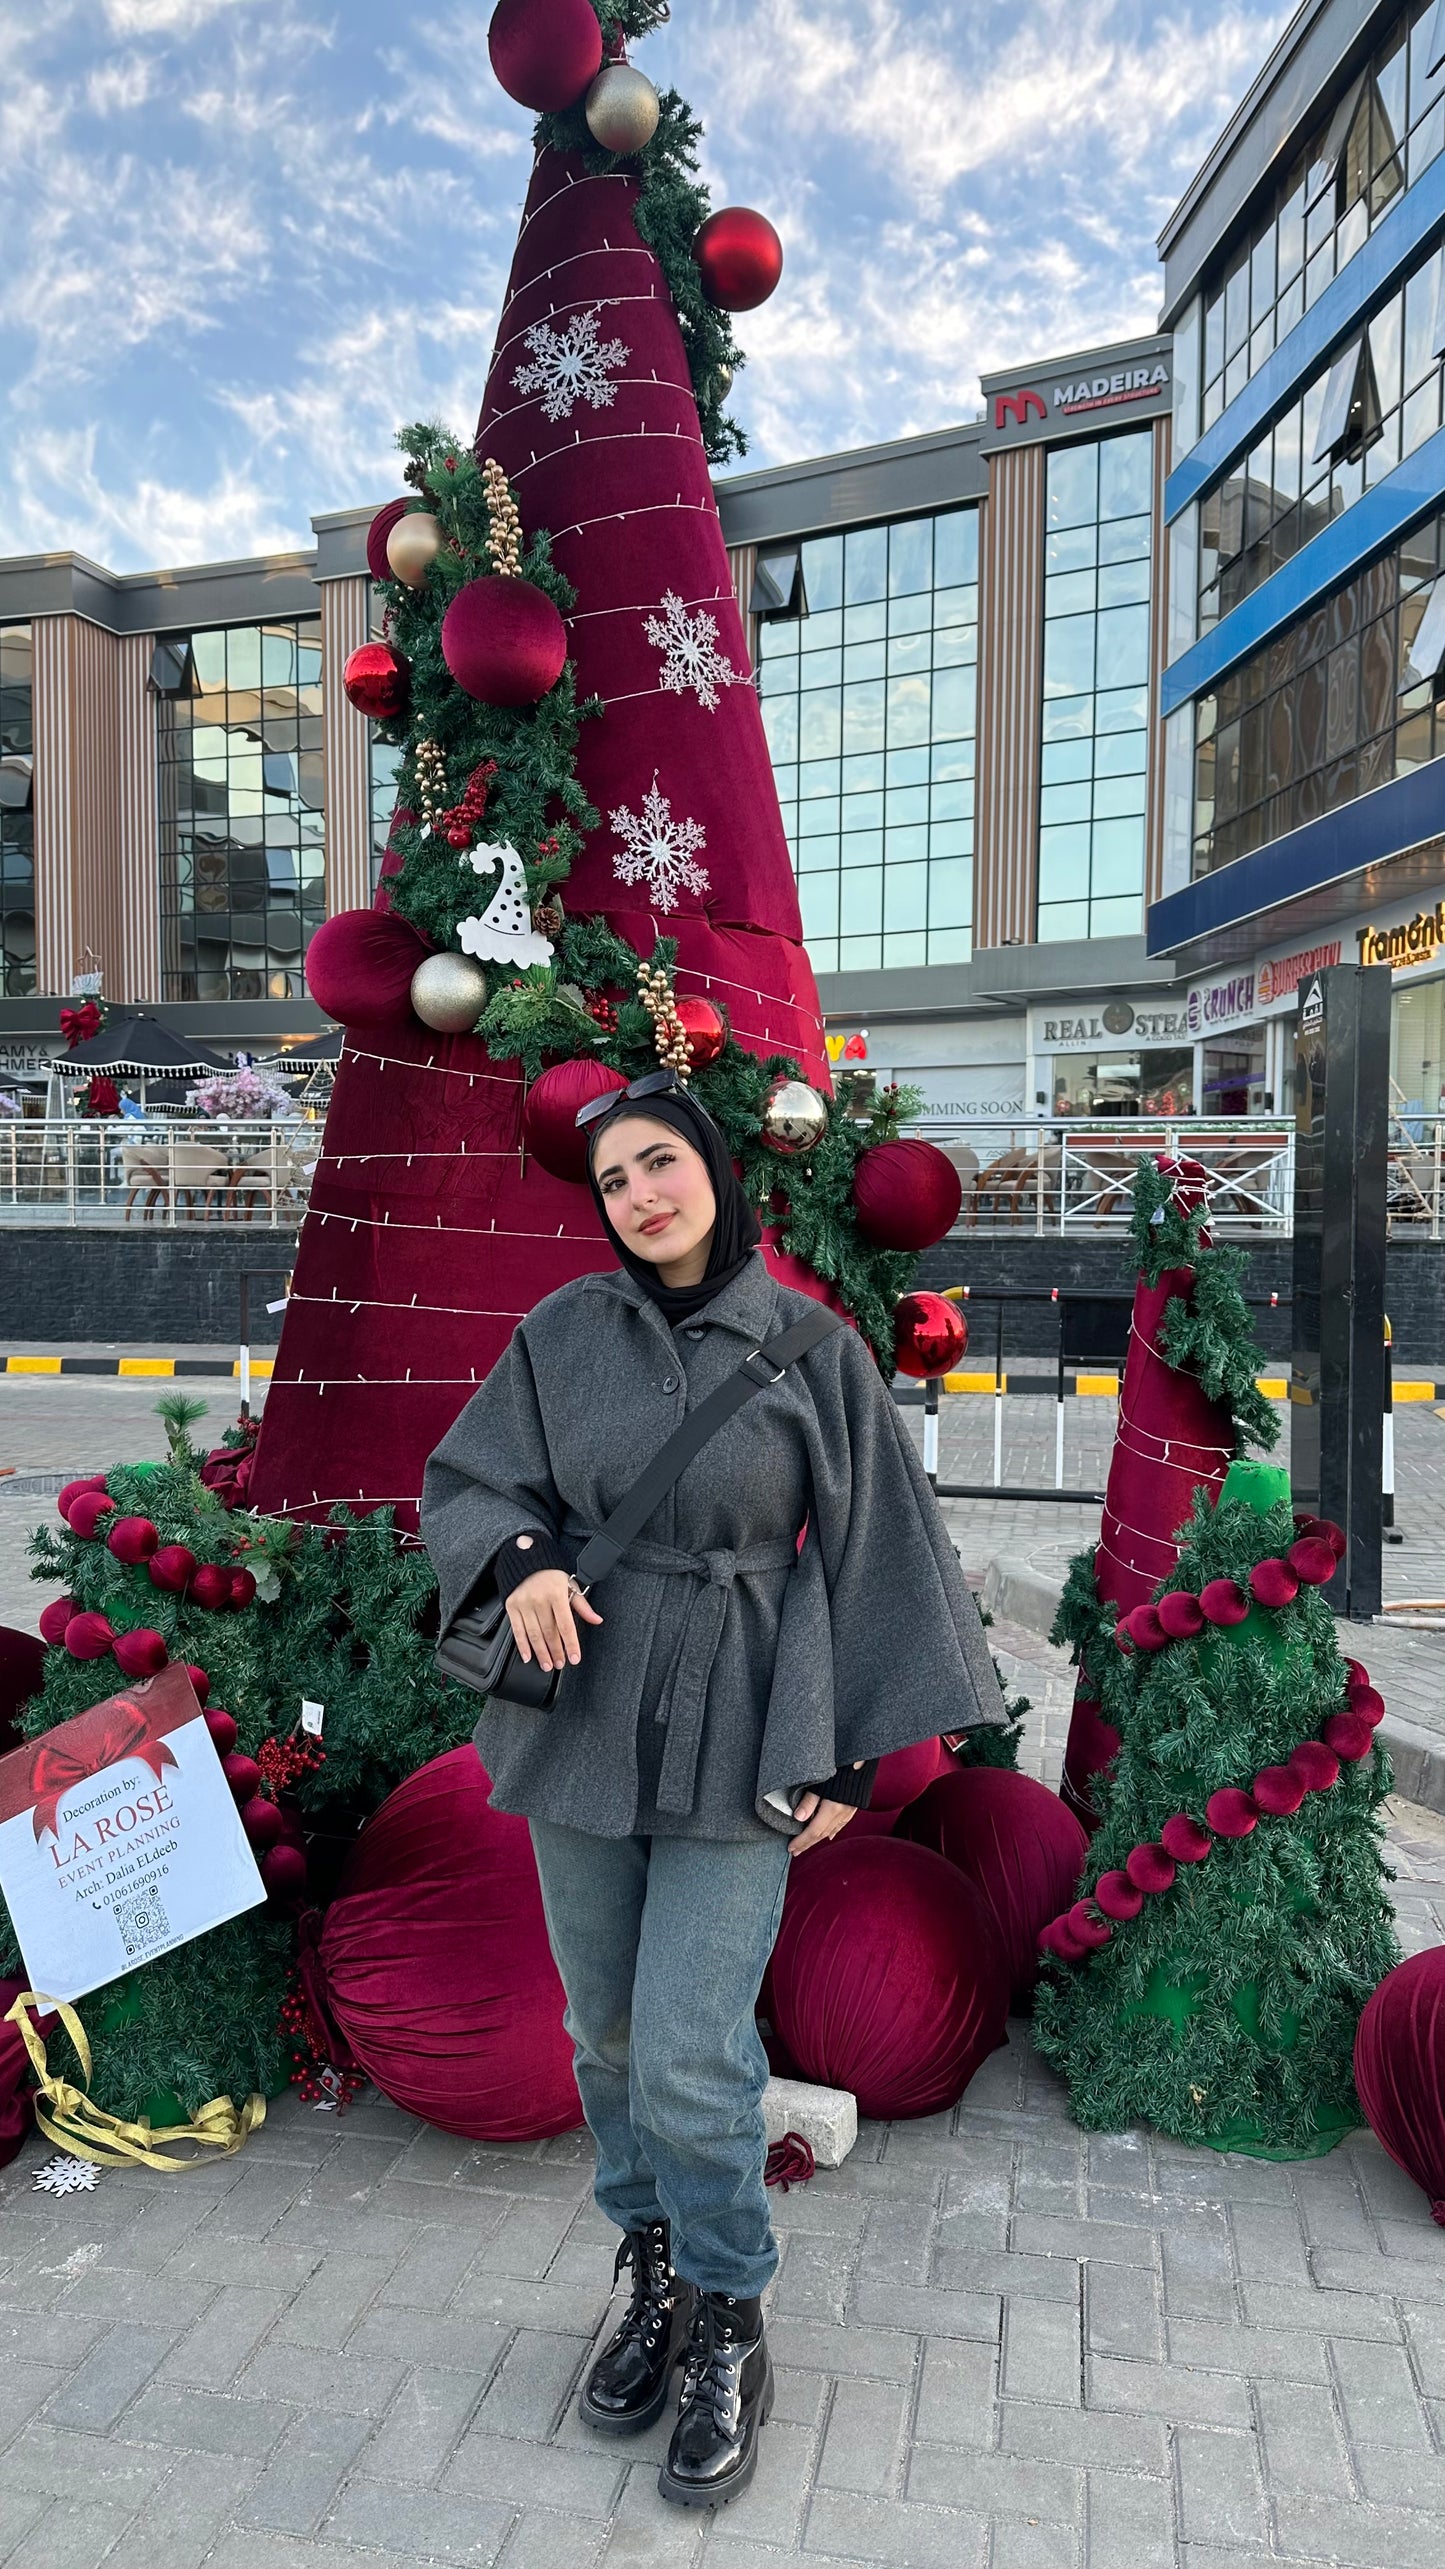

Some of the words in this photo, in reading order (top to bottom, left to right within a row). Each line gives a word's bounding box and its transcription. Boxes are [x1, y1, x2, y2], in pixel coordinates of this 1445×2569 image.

[1053, 364, 1169, 407] MADEIRA
[1204, 974, 1255, 1022] CRUNCH
[1043, 1018, 1103, 1042] REAL
[919, 1102, 977, 1116] MMING
[980, 1100, 1025, 1114] SOON
[62, 1785, 122, 1823] Decoration
[122, 1775, 141, 1793] by:
[48, 1832, 93, 1869] LA
[93, 1785, 174, 1846] ROSE
[58, 1856, 104, 1890] EVENT
[107, 1815, 182, 1863] PLANNING
[75, 1879, 104, 1902] Arch:
[105, 1864, 136, 1887] Dalia
[136, 1839, 179, 1869] ELdeeb
[102, 1864, 170, 1906] 01061690916
